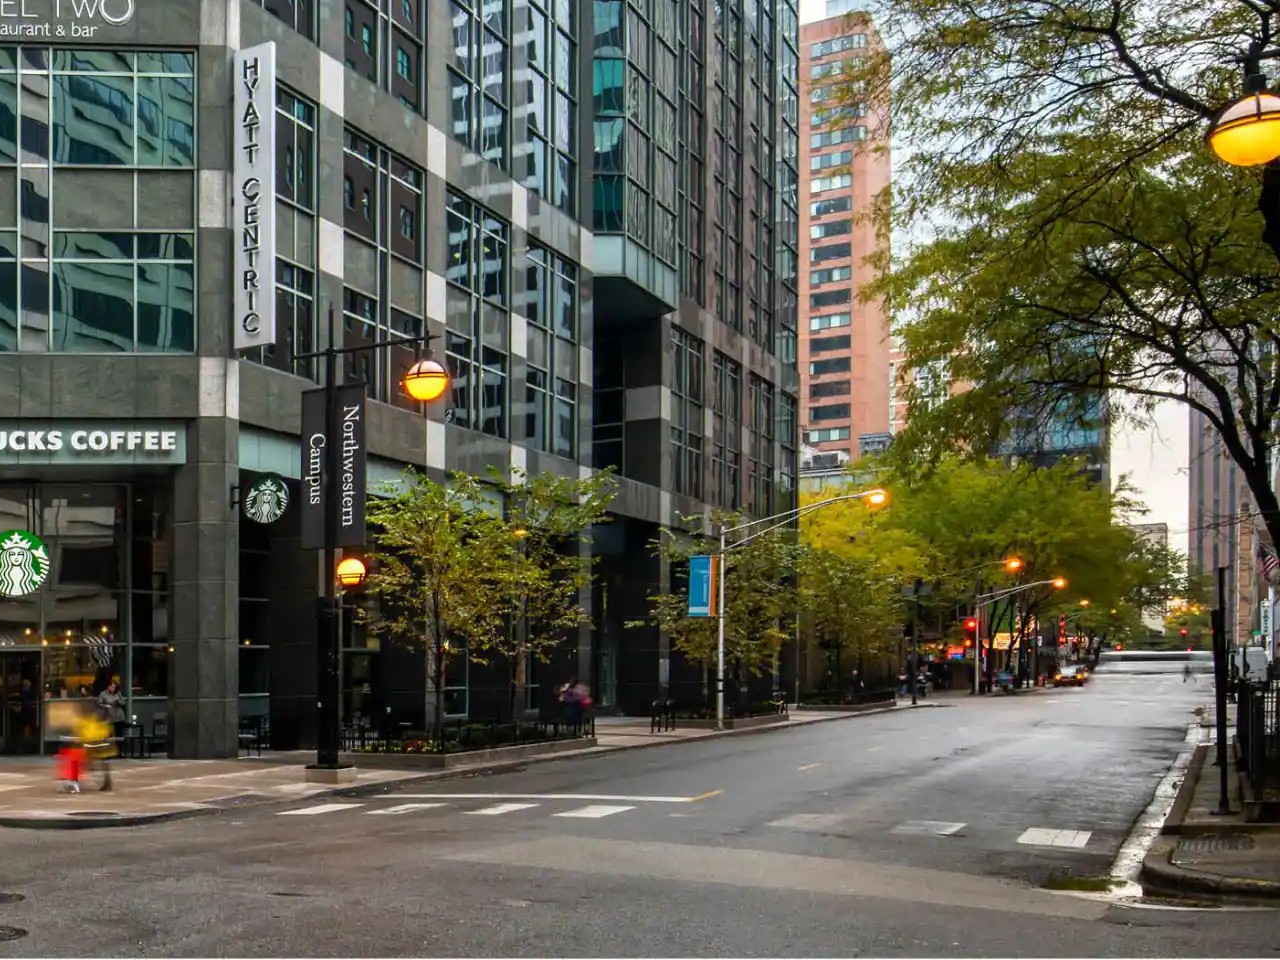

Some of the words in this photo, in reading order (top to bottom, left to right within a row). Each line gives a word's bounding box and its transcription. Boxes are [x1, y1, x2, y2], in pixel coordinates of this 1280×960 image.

[55, 24, 66, 37] &
[71, 22, 98, 38] bar
[242, 57, 260, 165] HYATT
[241, 177, 261, 334] CENTRIC
[71, 430, 177, 451] COFFEE
[304, 433, 326, 505] Campus
[342, 404, 360, 527] Northwestern
